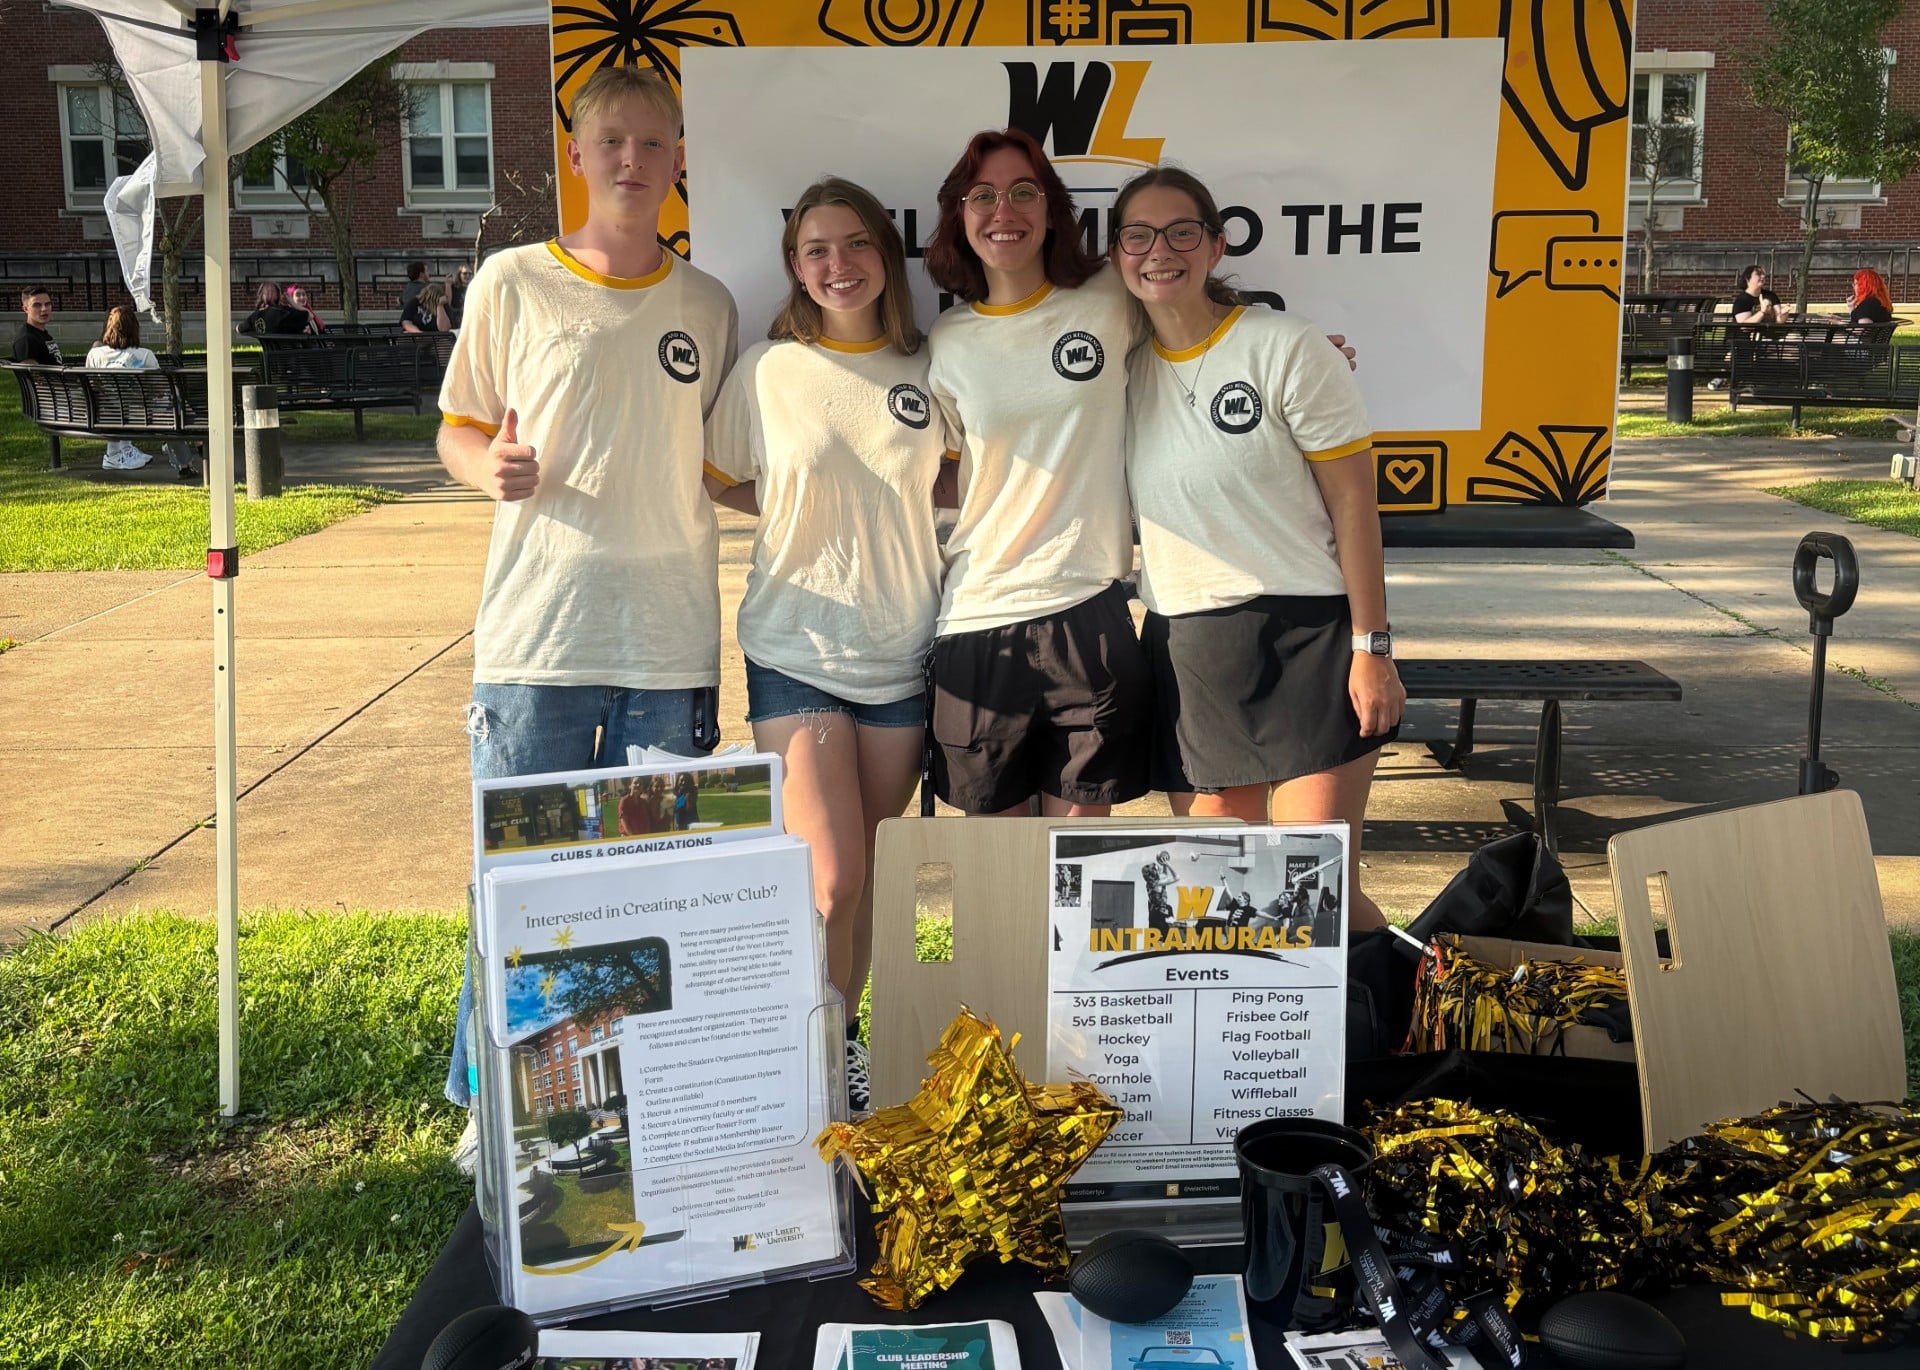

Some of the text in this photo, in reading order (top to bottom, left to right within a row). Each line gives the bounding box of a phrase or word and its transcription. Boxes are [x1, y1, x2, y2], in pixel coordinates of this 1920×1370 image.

[1000, 60, 1166, 158] WL
[1281, 202, 1423, 256] THE
[672, 345, 695, 367] WL
[1065, 345, 1093, 366] WL
[901, 396, 925, 414] WL
[1224, 396, 1251, 416] WL
[551, 836, 713, 862] CLUBS & ORGANIZATIONS
[525, 884, 778, 929] Interested in Creating a New Club?
[1090, 926, 1313, 952] INTRAMURALS
[1166, 968, 1229, 981] Events
[1073, 993, 1173, 1007] 3v3 Basketball
[1232, 992, 1304, 1005] Ping Pong
[1072, 1013, 1173, 1026] 5v5 Basketball
[1226, 1010, 1310, 1022] Frisbee Golf
[1098, 1033, 1151, 1046] Hockey
[1222, 1029, 1311, 1044] Flag Football
[1105, 1053, 1139, 1066] Yoga
[1232, 1048, 1299, 1063] Volleyball
[1223, 1067, 1307, 1082] Racquetball
[1121, 1092, 1151, 1103] Jam
[1232, 1087, 1297, 1100] Wiffleball
[1213, 1106, 1314, 1119] Fitness Classes
[1107, 1132, 1143, 1143] occer
[1329, 1170, 1351, 1199] WL
[1374, 1225, 1392, 1245] WL
[733, 1233, 757, 1253] WL
[1428, 1250, 1453, 1264] WL
[1378, 1295, 1397, 1323] WL
[876, 1351, 970, 1362] CLUB LEADERSHIP
[901, 1361, 948, 1370] MEETING
